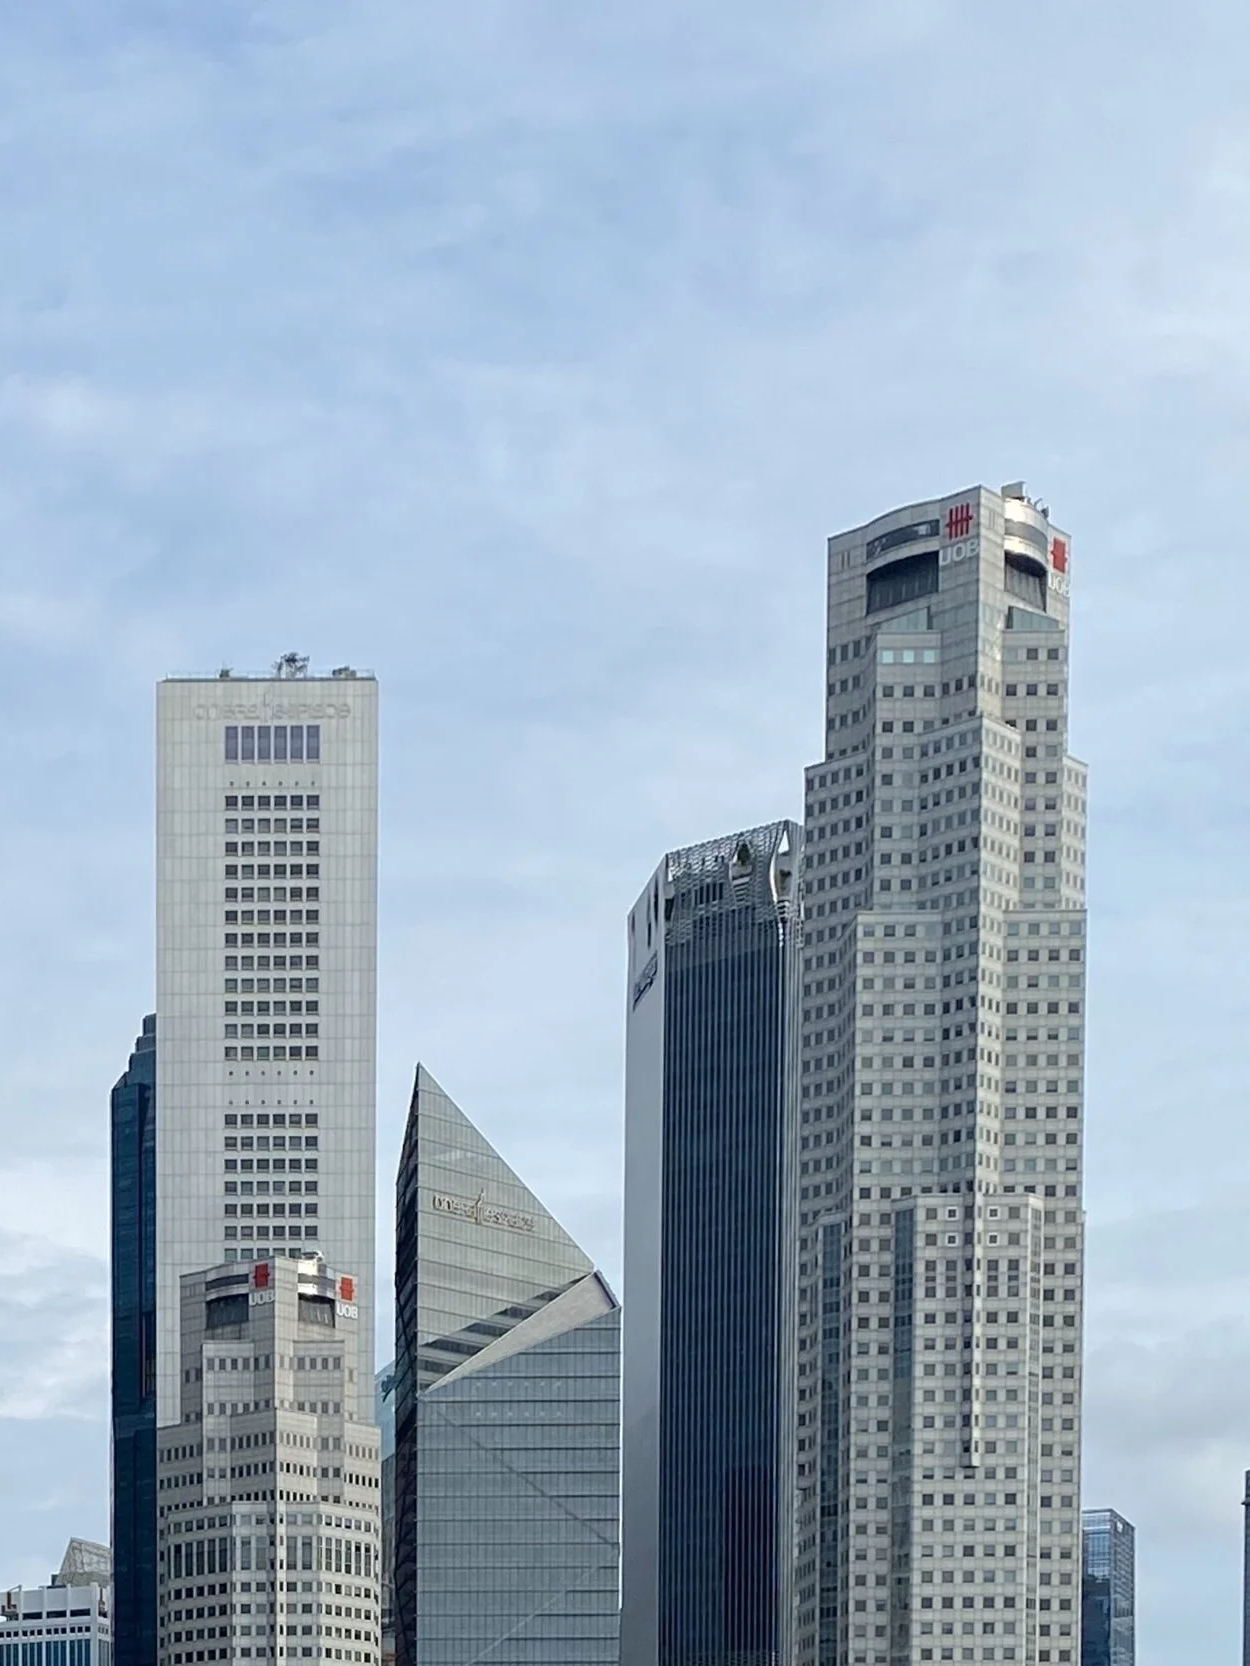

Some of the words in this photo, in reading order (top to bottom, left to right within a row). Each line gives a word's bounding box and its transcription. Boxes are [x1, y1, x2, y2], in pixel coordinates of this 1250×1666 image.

[940, 539, 979, 566] UOB
[249, 1290, 275, 1306] UOB
[336, 1301, 358, 1319] UOB
